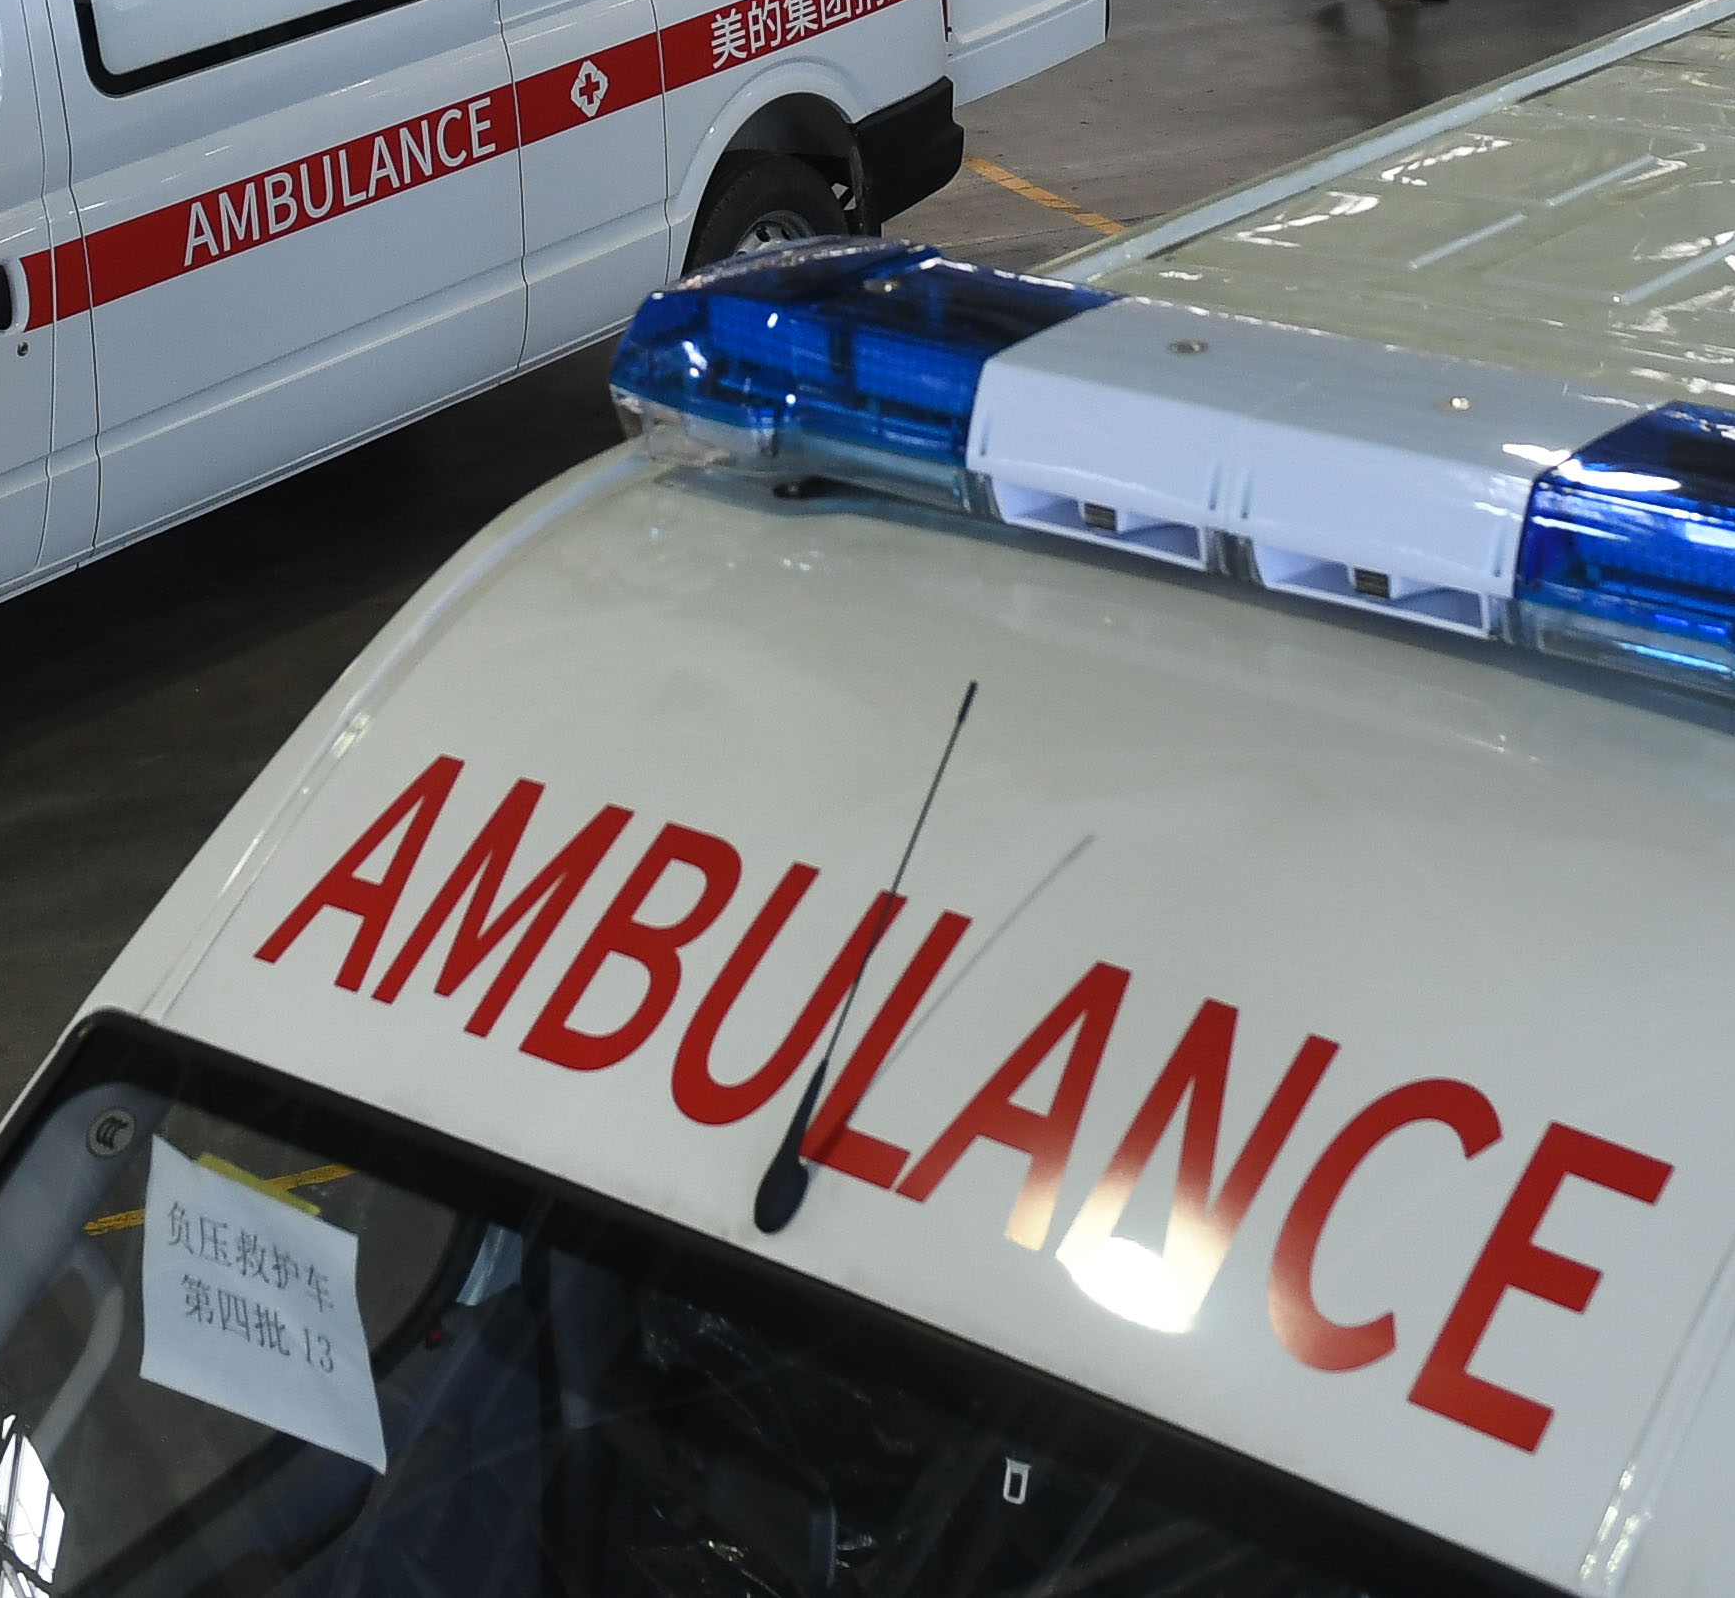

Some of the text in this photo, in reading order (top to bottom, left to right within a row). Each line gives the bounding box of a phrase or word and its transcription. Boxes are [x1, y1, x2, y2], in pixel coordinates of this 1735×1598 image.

[182, 97, 498, 269] AMBULANCE
[254, 755, 1674, 1454] AMBULANCE
[164, 1202, 335, 1313] 负压救护车
[181, 1272, 336, 1375] 第四批 13
